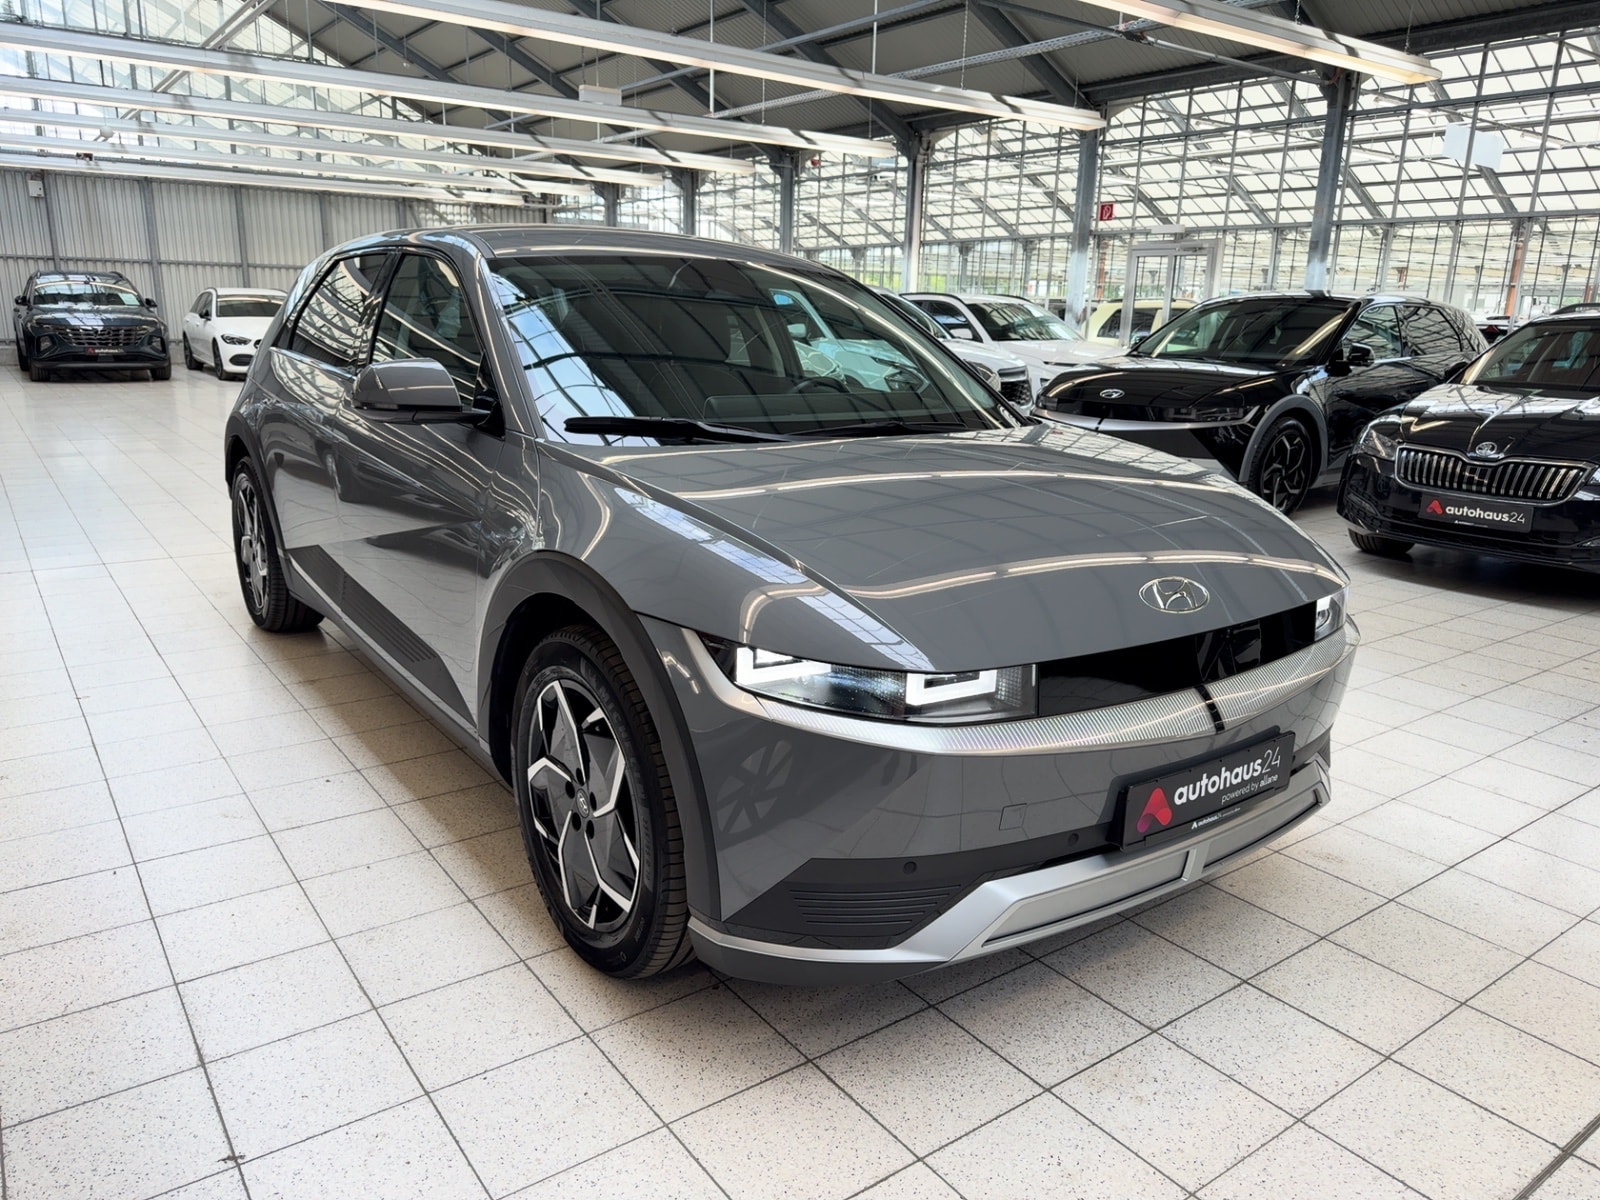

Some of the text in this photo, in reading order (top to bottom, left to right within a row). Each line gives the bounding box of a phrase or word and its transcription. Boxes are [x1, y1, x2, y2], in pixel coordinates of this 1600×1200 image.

[1445, 506, 1525, 524] autohaus24
[1174, 746, 1281, 805] autohaus24
[1221, 773, 1279, 806] powered by allane
